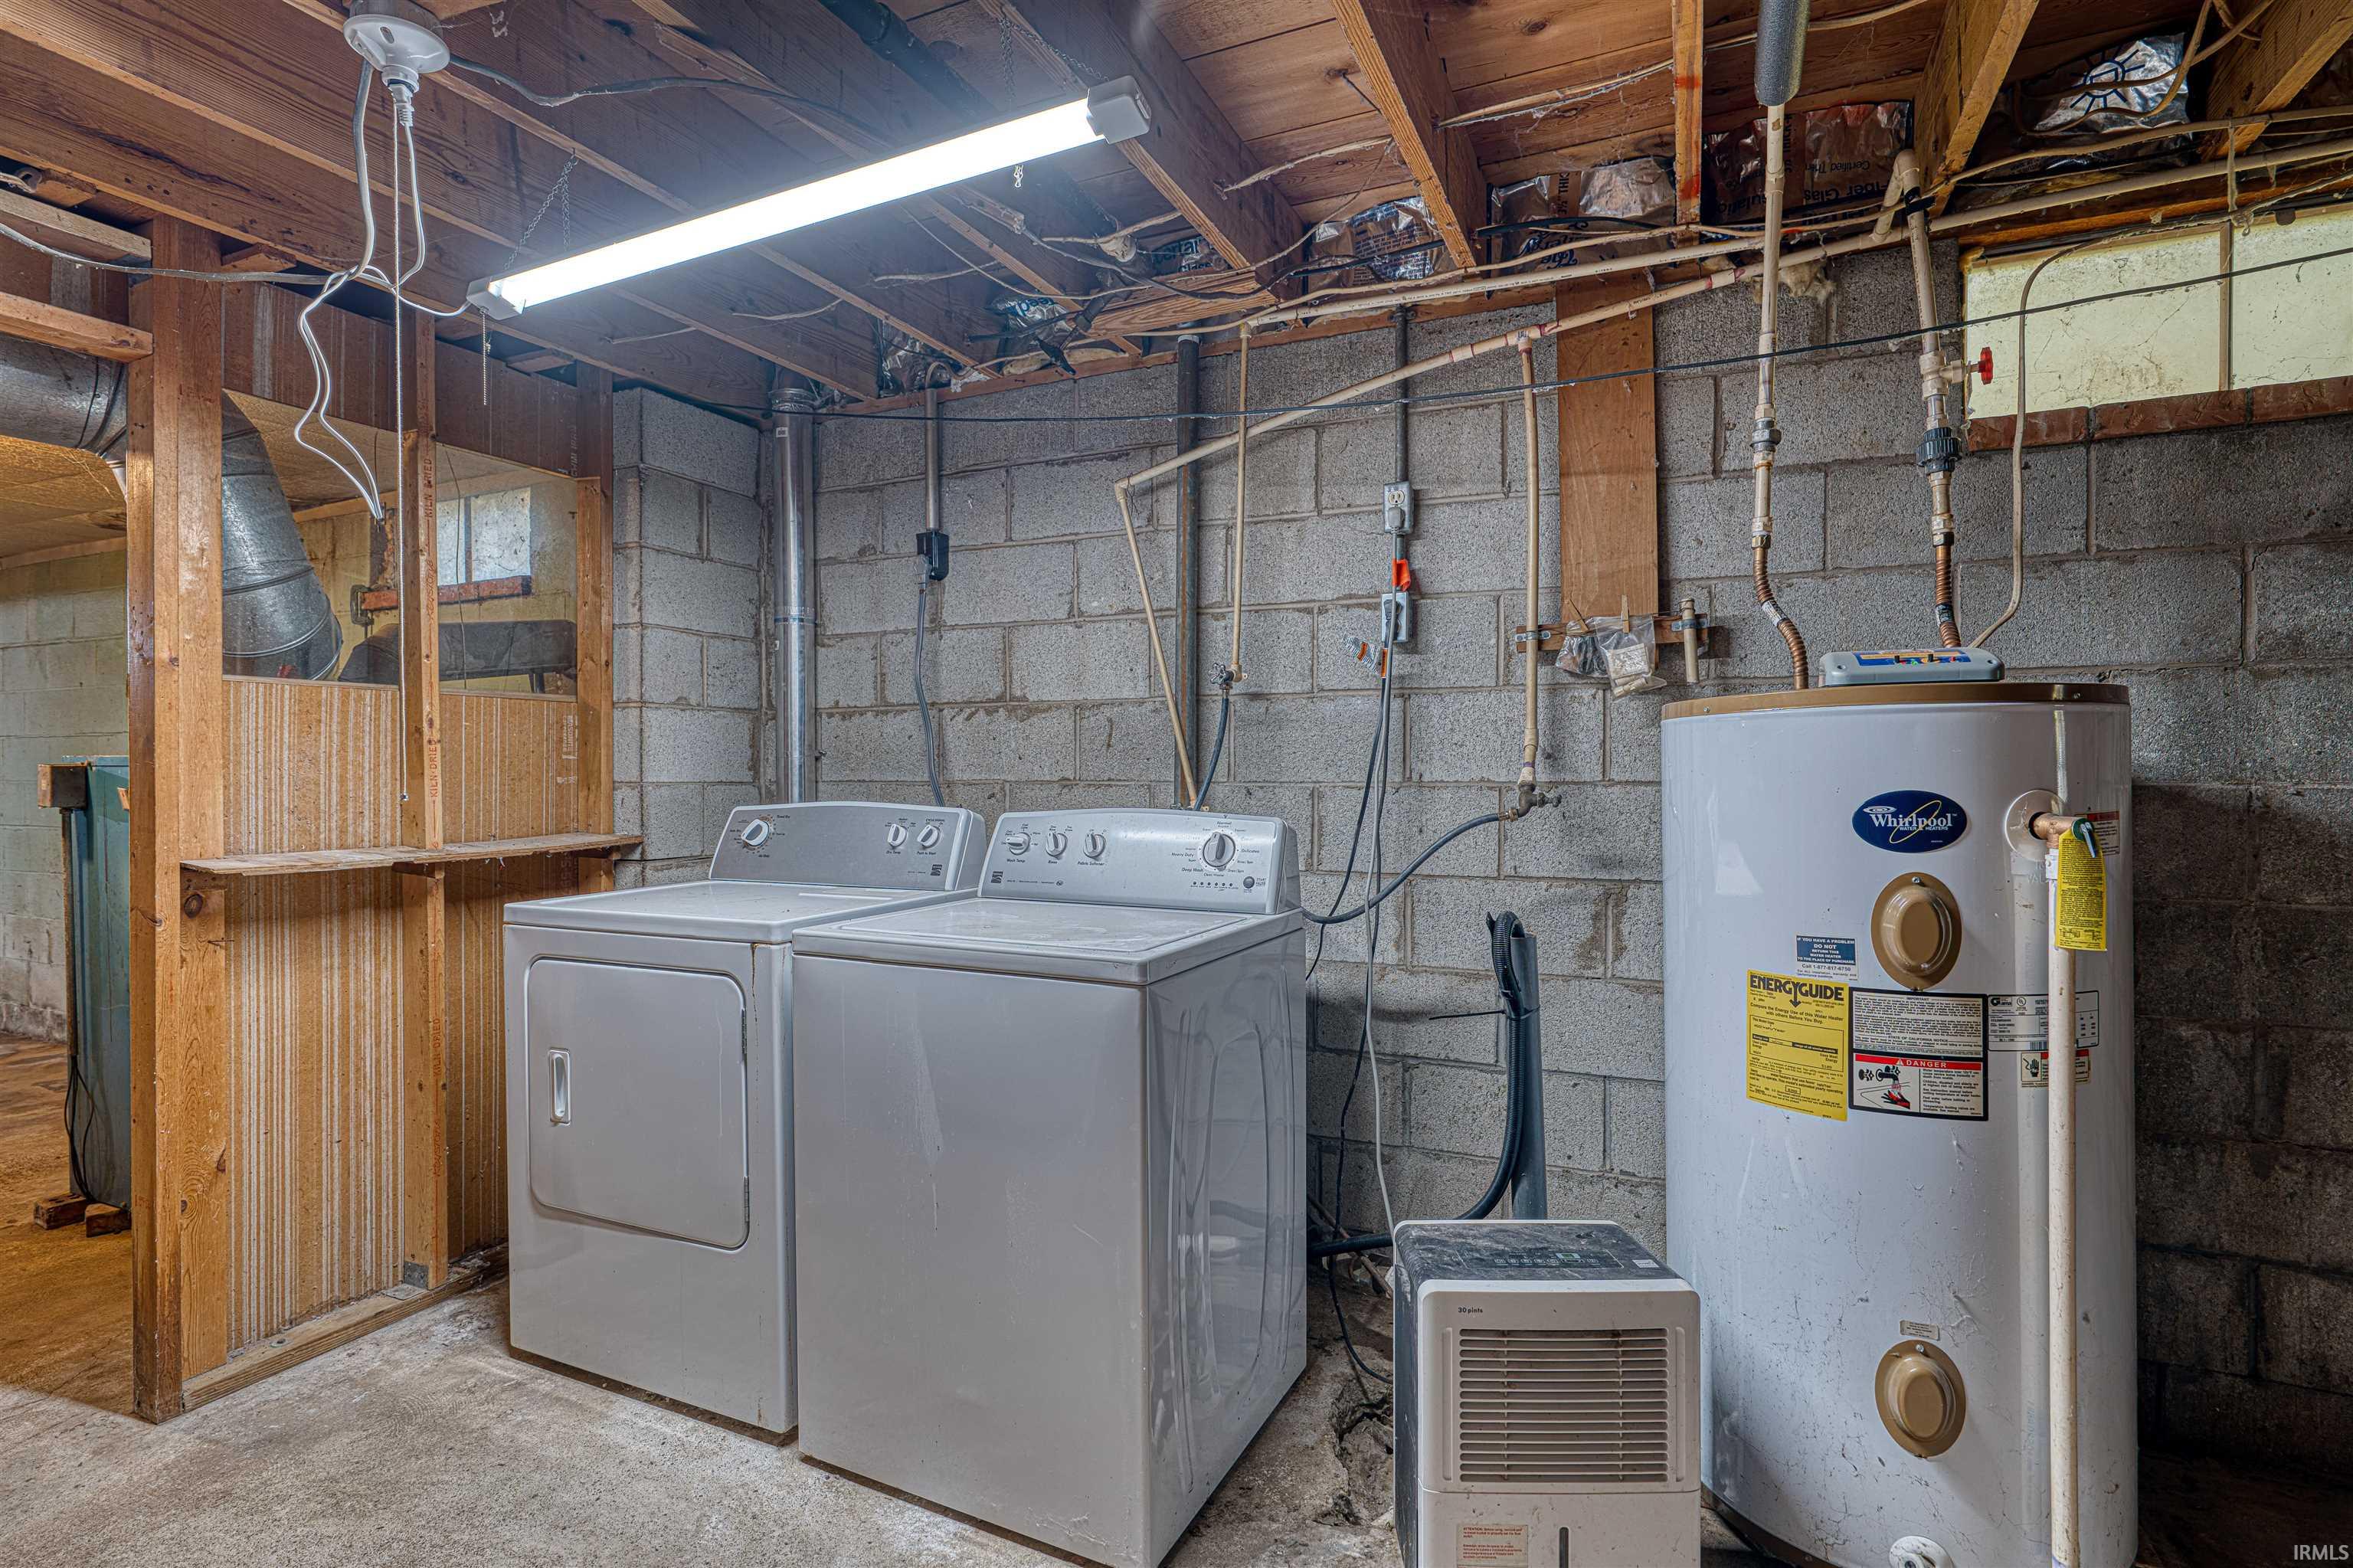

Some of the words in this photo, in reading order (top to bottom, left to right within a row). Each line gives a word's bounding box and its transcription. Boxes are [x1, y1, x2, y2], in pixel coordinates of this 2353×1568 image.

[1829, 159, 1870, 172] Certified
[424, 493, 433, 518] KILN
[430, 774, 438, 797] KILN
[1870, 813, 1953, 831] Whirlpool
[1749, 974, 1844, 1003] ENERGYGUIDE
[1775, 1006, 1789, 1014] Energy
[1906, 1059, 1947, 1068] DANGER
[1467, 1306, 1484, 1314] pints
